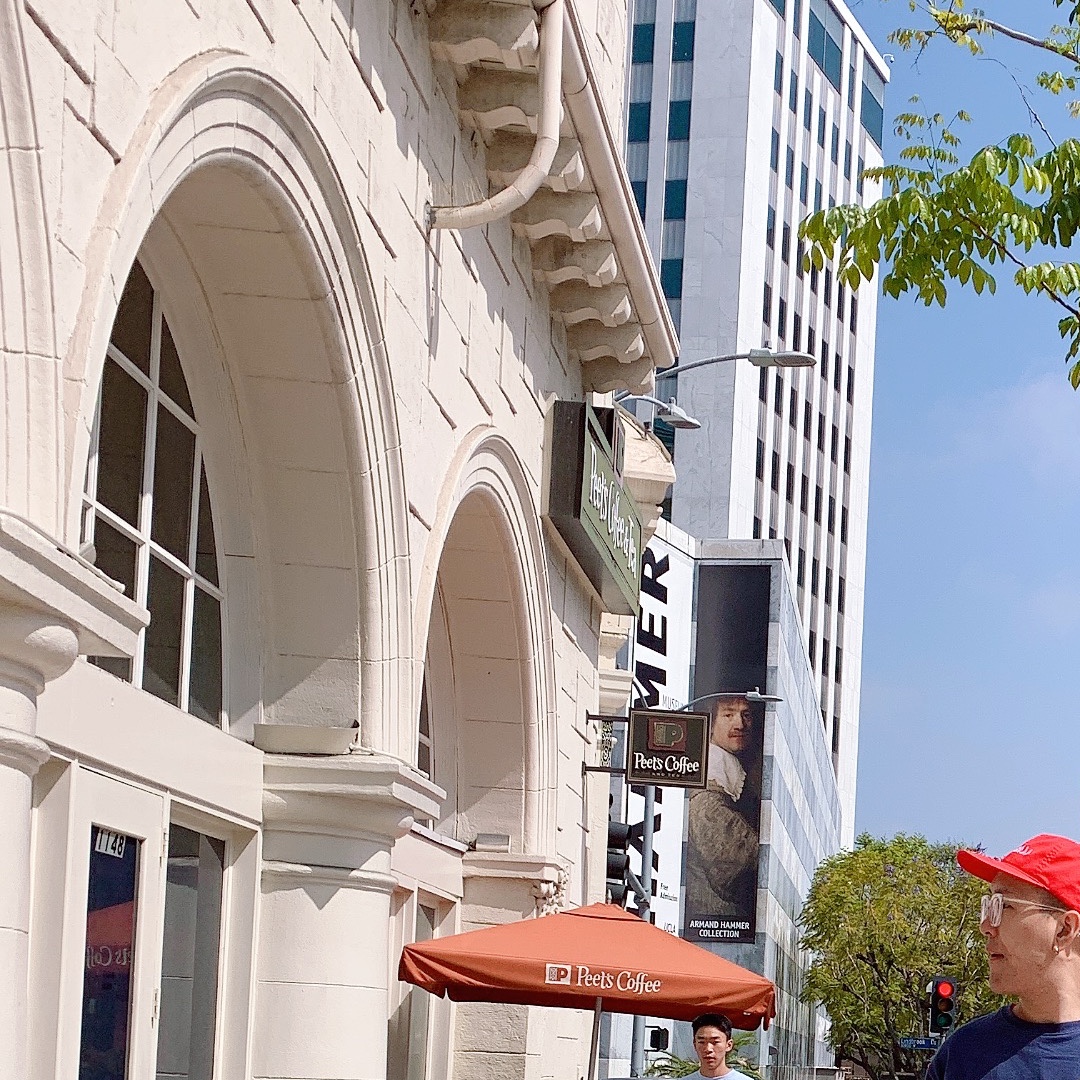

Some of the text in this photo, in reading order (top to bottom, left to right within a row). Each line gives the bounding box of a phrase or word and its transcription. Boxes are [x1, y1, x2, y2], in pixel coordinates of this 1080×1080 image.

[607, 480, 625, 549] Coffee
[627, 515, 637, 579] Tea
[664, 755, 700, 775] Coffee
[97, 829, 125, 856] 1148
[689, 920, 750, 930] ARMAND HAMMER
[698, 929, 740, 938] COLLECTION
[616, 970, 661, 995] Coffee
